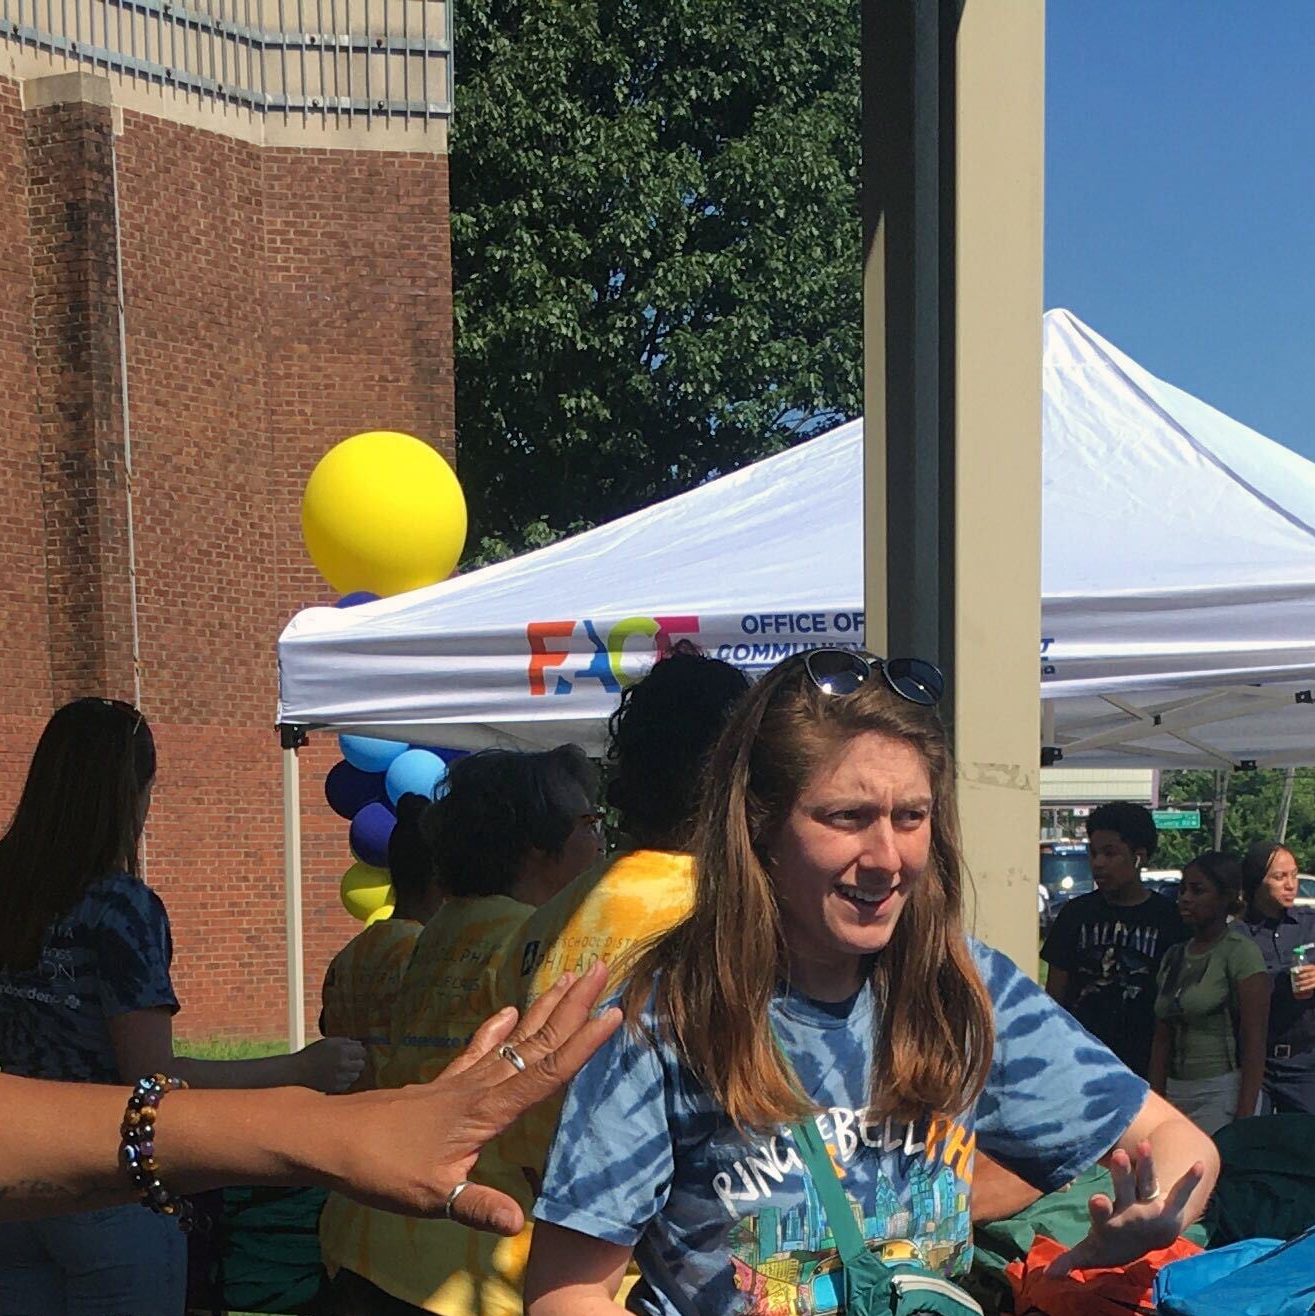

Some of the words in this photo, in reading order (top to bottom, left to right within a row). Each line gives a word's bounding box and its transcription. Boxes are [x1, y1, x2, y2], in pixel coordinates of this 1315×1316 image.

[740, 613, 828, 634] OFFICE
[833, 612, 865, 632] OF
[717, 642, 865, 662] COMMU
[561, 936, 600, 949] SCHOOL
[713, 1137, 803, 1221] RING
[828, 1106, 925, 1162] BELL
